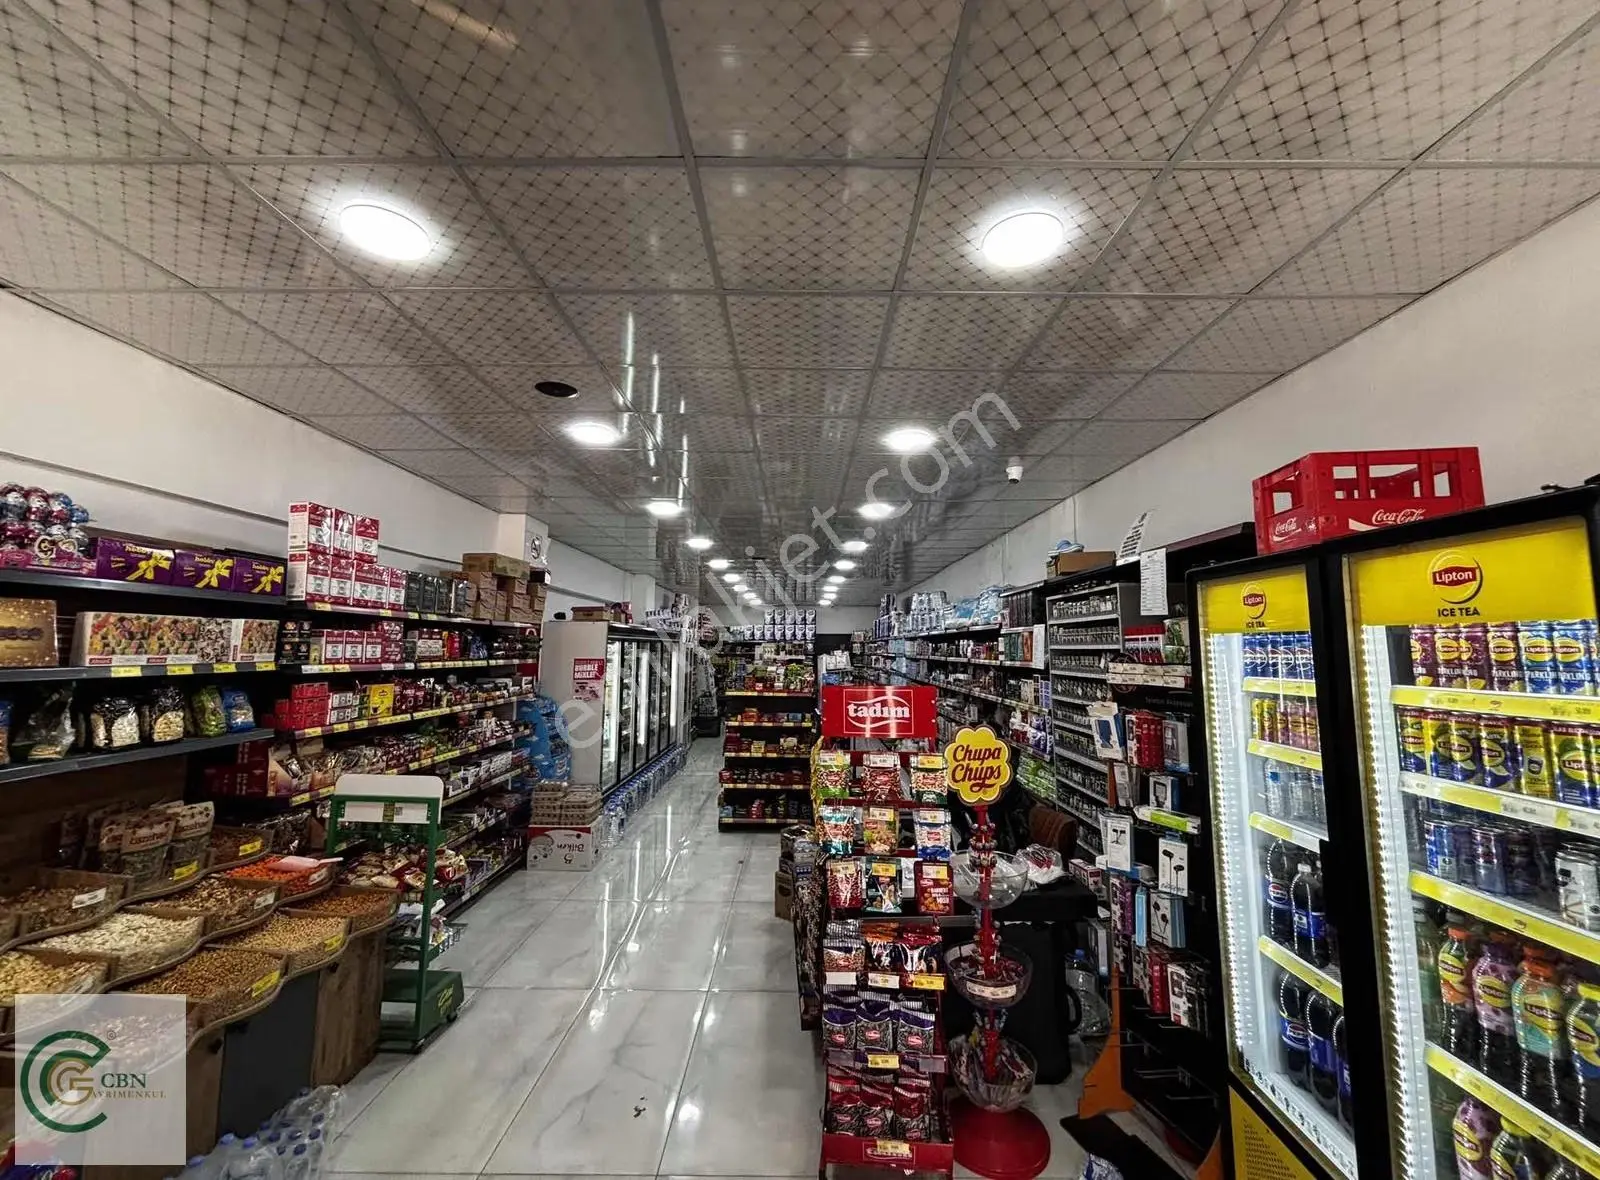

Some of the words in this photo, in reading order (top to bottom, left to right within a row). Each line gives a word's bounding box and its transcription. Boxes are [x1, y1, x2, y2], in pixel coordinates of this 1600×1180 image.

[1275, 517, 1297, 535] Coca-Cola
[1436, 571, 1473, 584] Lipton
[1244, 595, 1263, 604] Lipton
[1438, 608, 1457, 617] ICE
[1458, 607, 1481, 616] TEA
[848, 702, 910, 718] tadım
[952, 744, 1003, 766] Chupa
[951, 763, 1002, 793] Chups
